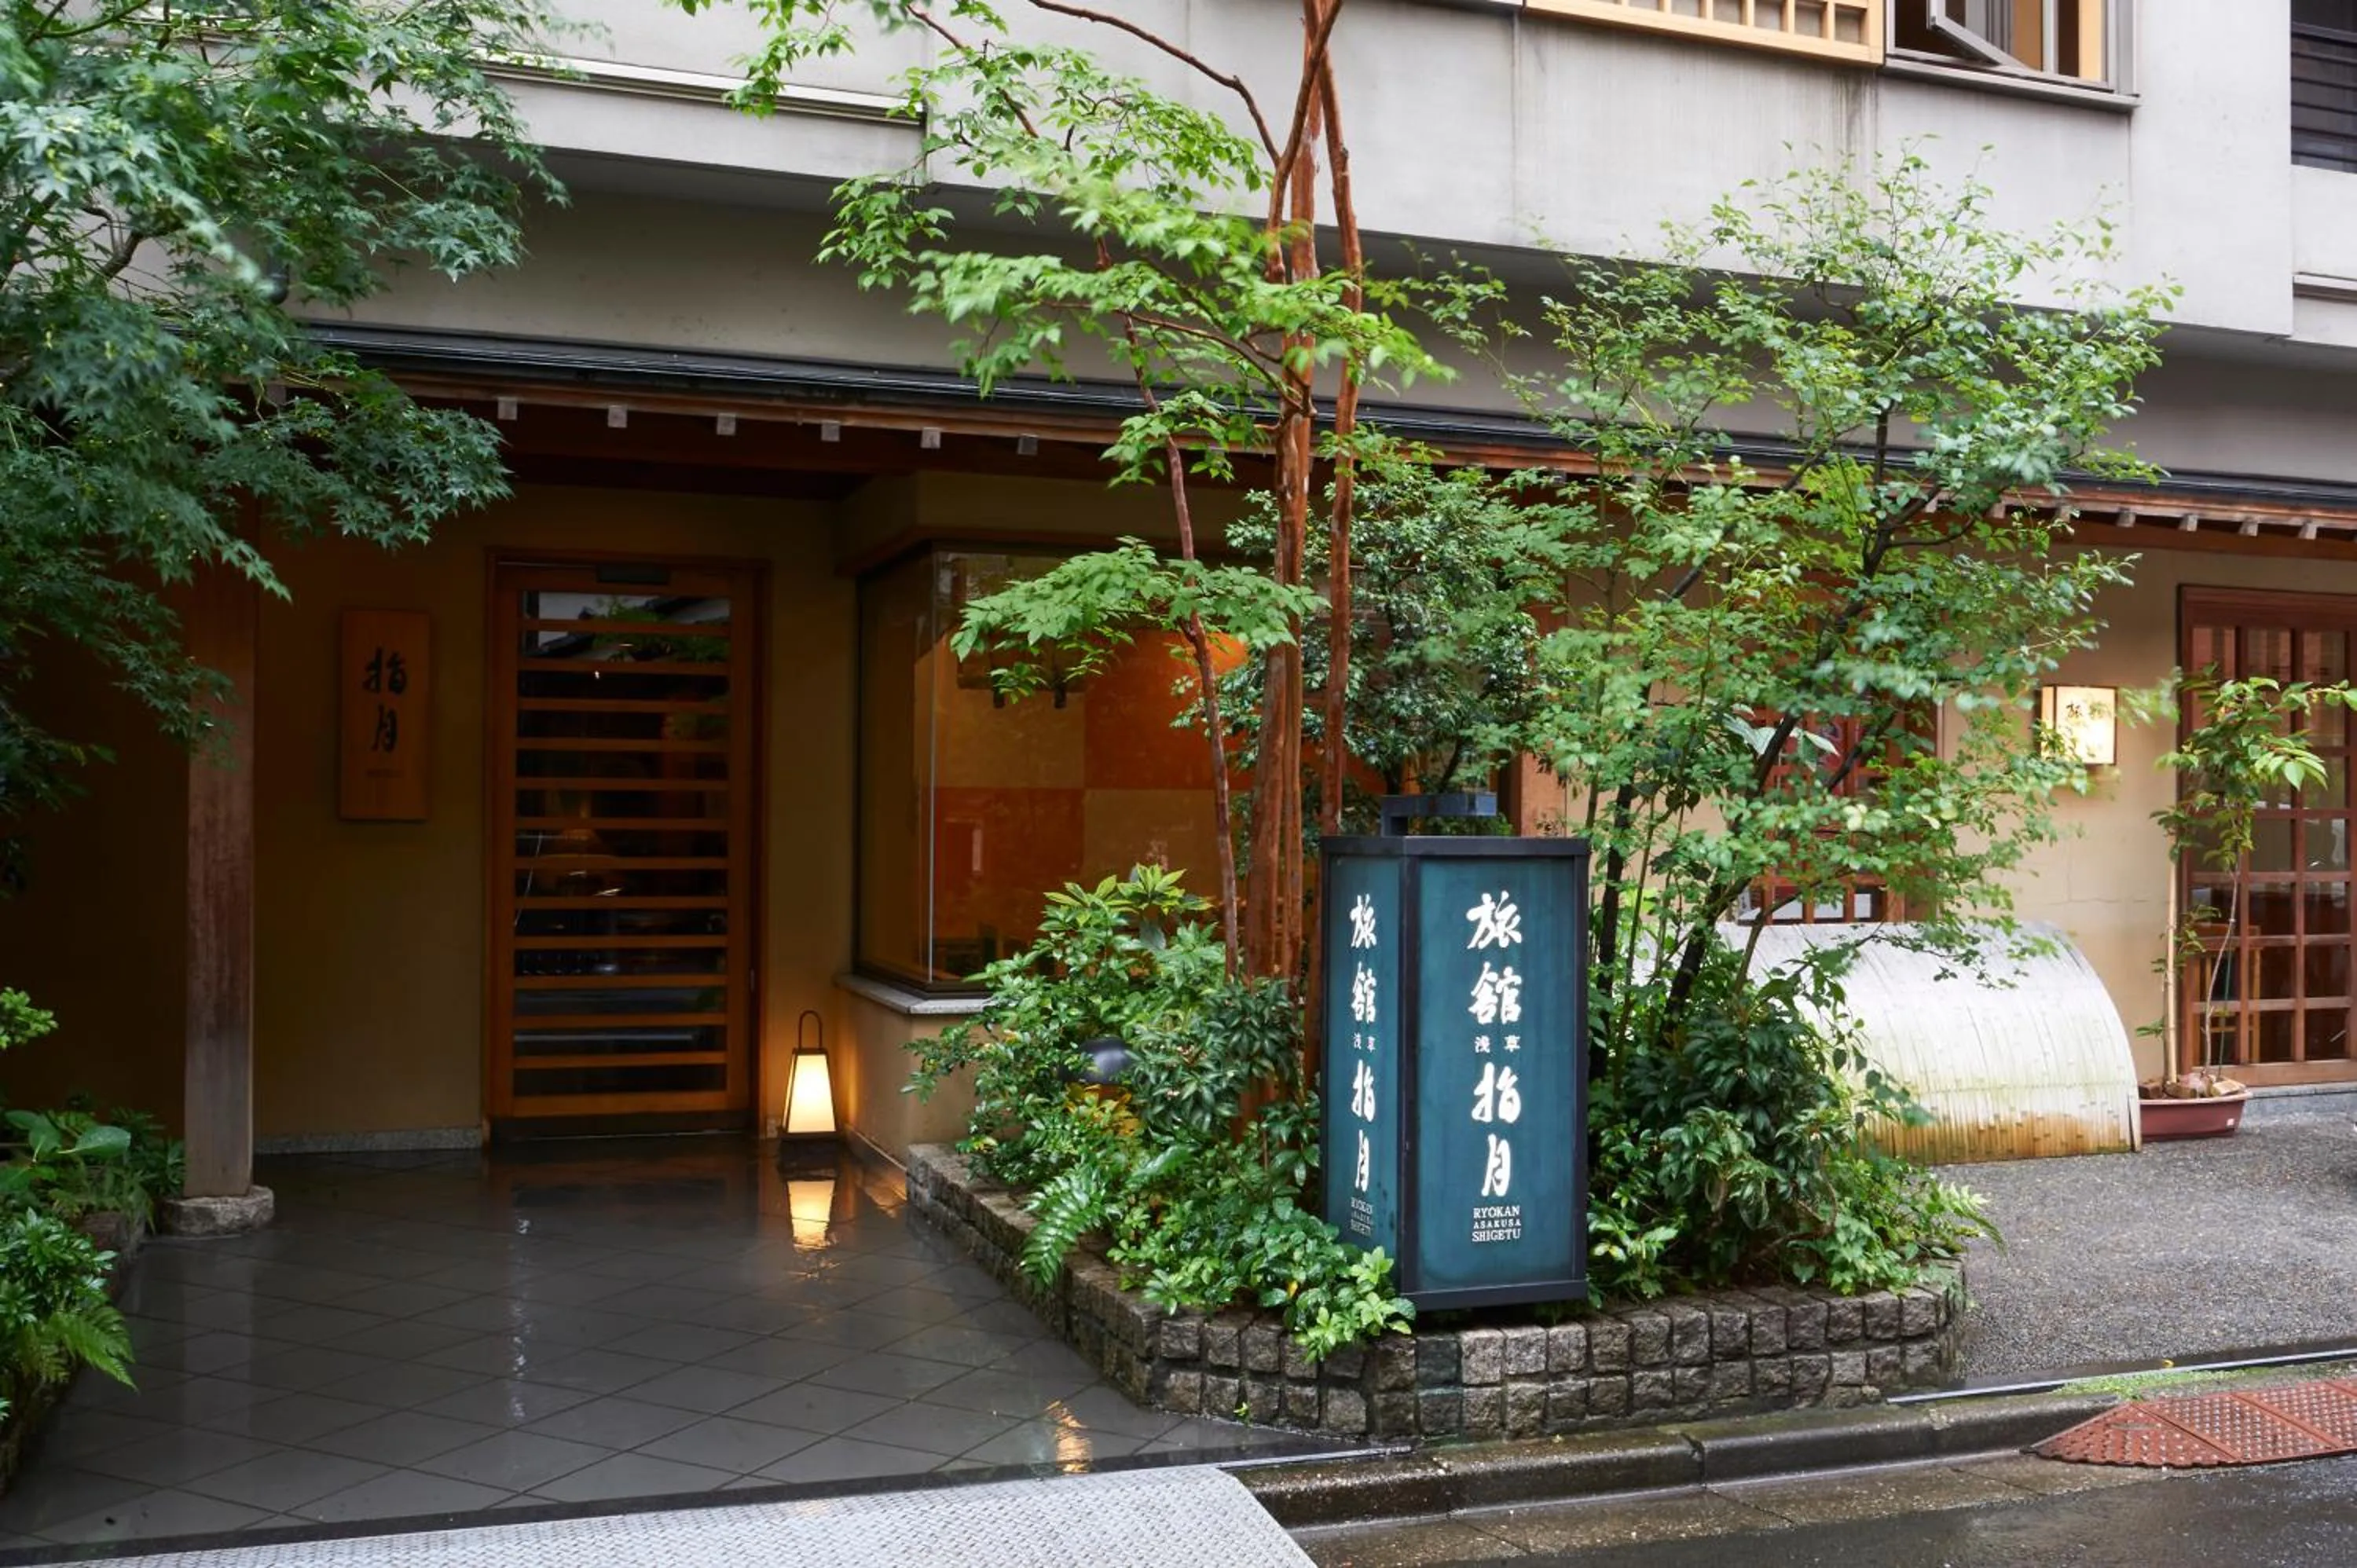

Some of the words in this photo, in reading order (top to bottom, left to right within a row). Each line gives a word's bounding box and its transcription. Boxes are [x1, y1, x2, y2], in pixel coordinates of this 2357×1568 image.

[1474, 1035, 1521, 1053] 浅草
[1351, 1059, 1376, 1192] 指月
[1471, 1061, 1522, 1197] 指月
[1473, 1205, 1520, 1218] RYOKAN
[1473, 1218, 1522, 1229] ASAKUSA
[1472, 1229, 1521, 1242] SHIGETU
